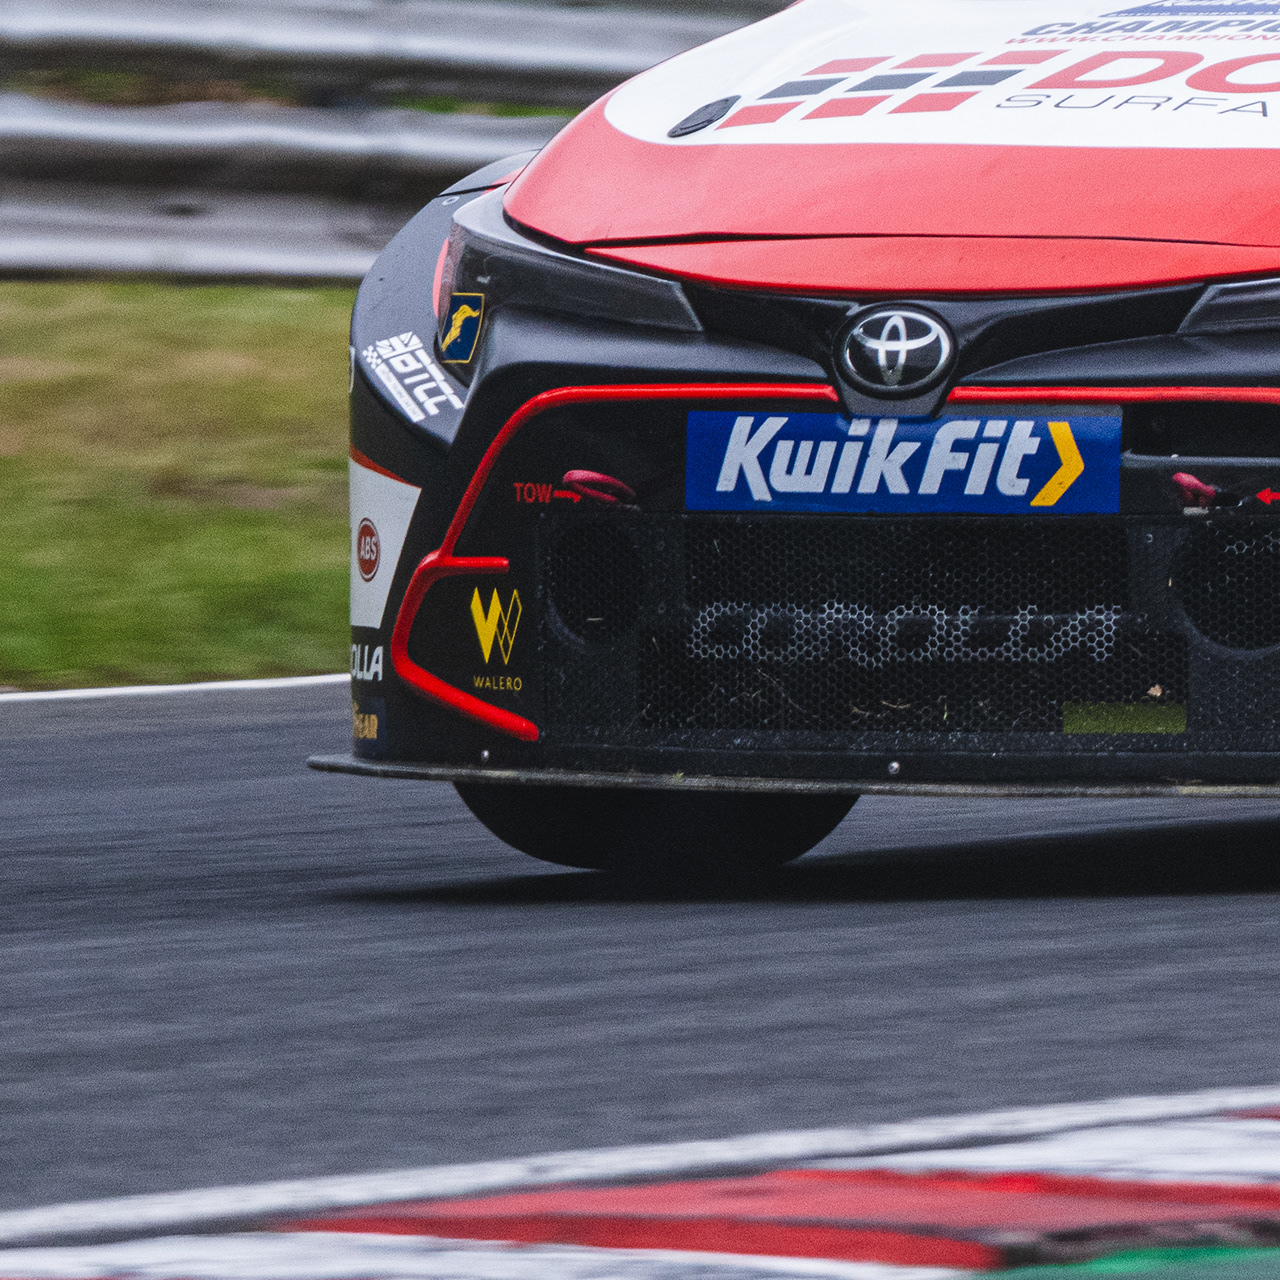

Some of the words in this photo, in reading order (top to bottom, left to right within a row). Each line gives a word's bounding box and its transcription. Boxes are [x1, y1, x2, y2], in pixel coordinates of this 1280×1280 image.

[513, 482, 552, 504] TOW
[360, 535, 377, 561] ABS
[473, 675, 523, 691] WALERO
